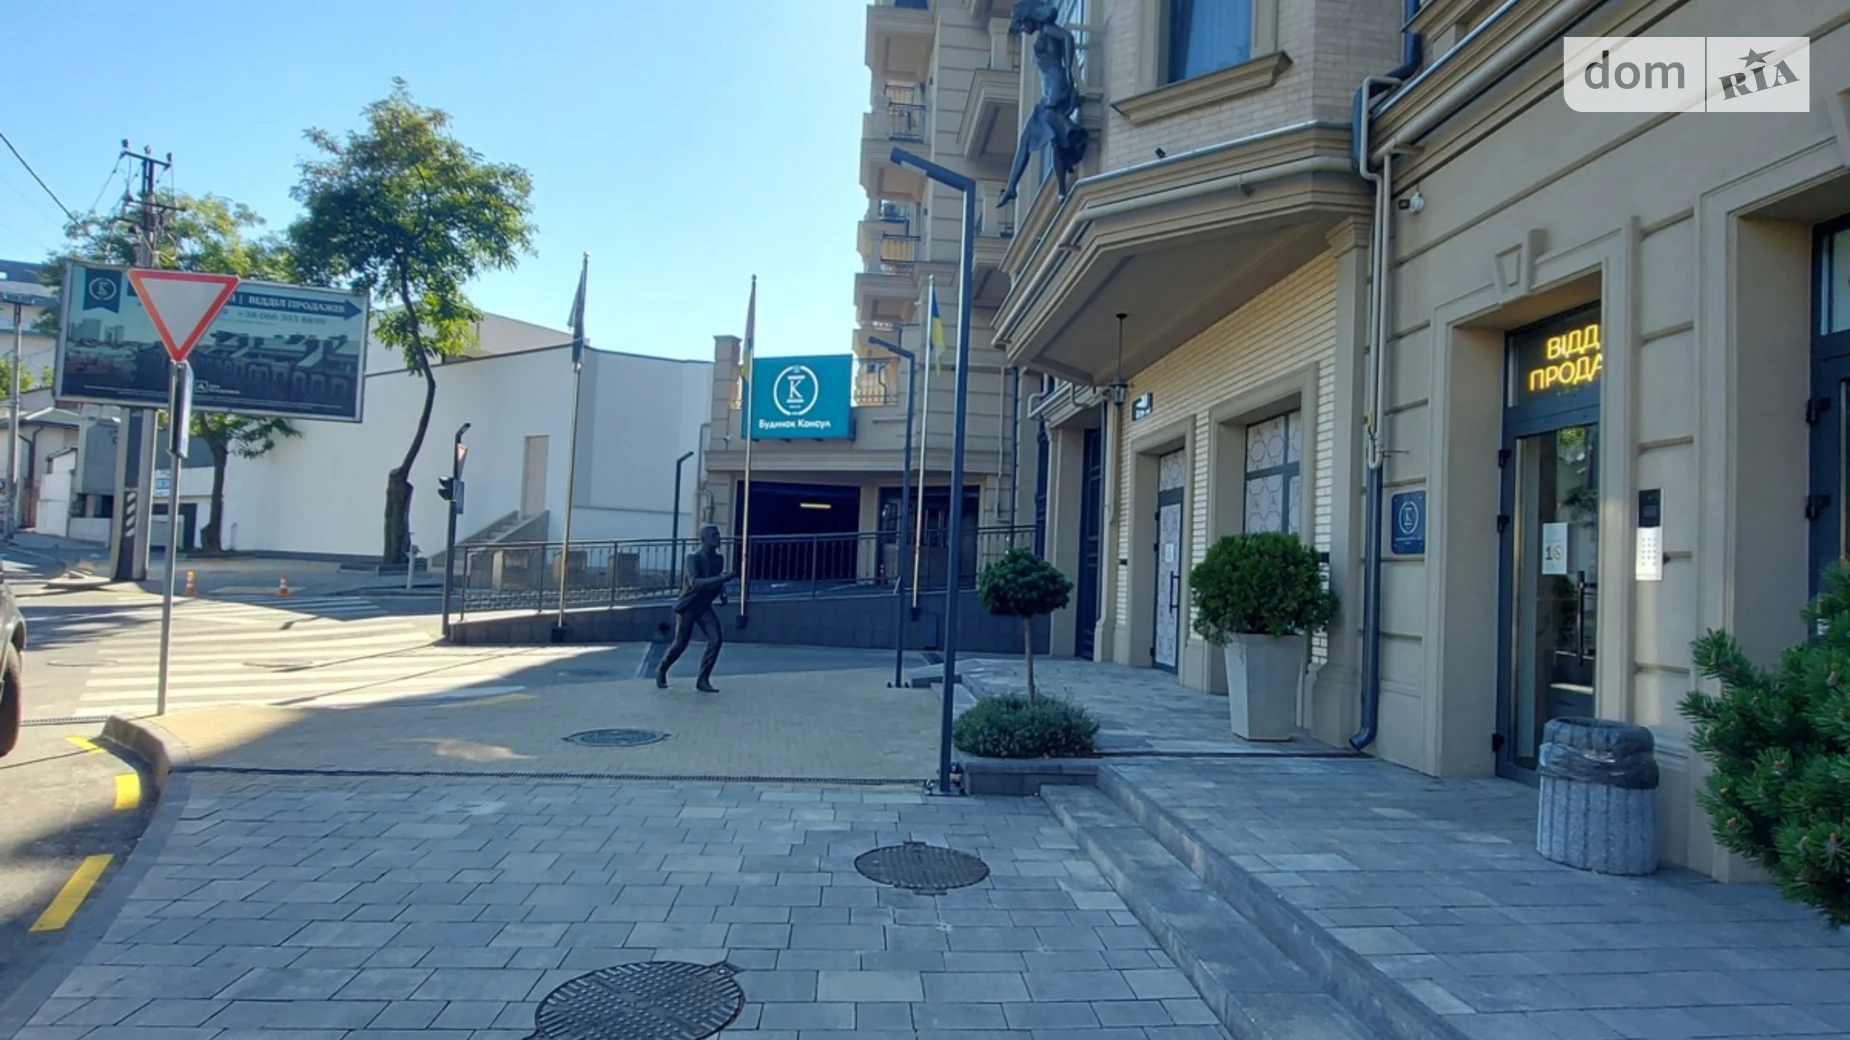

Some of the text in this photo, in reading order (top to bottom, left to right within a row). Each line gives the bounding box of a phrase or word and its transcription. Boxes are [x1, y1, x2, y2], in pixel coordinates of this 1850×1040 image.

[248, 295, 286, 309] ВІДДІЛ
[759, 418, 831, 429] Будинок Консул
